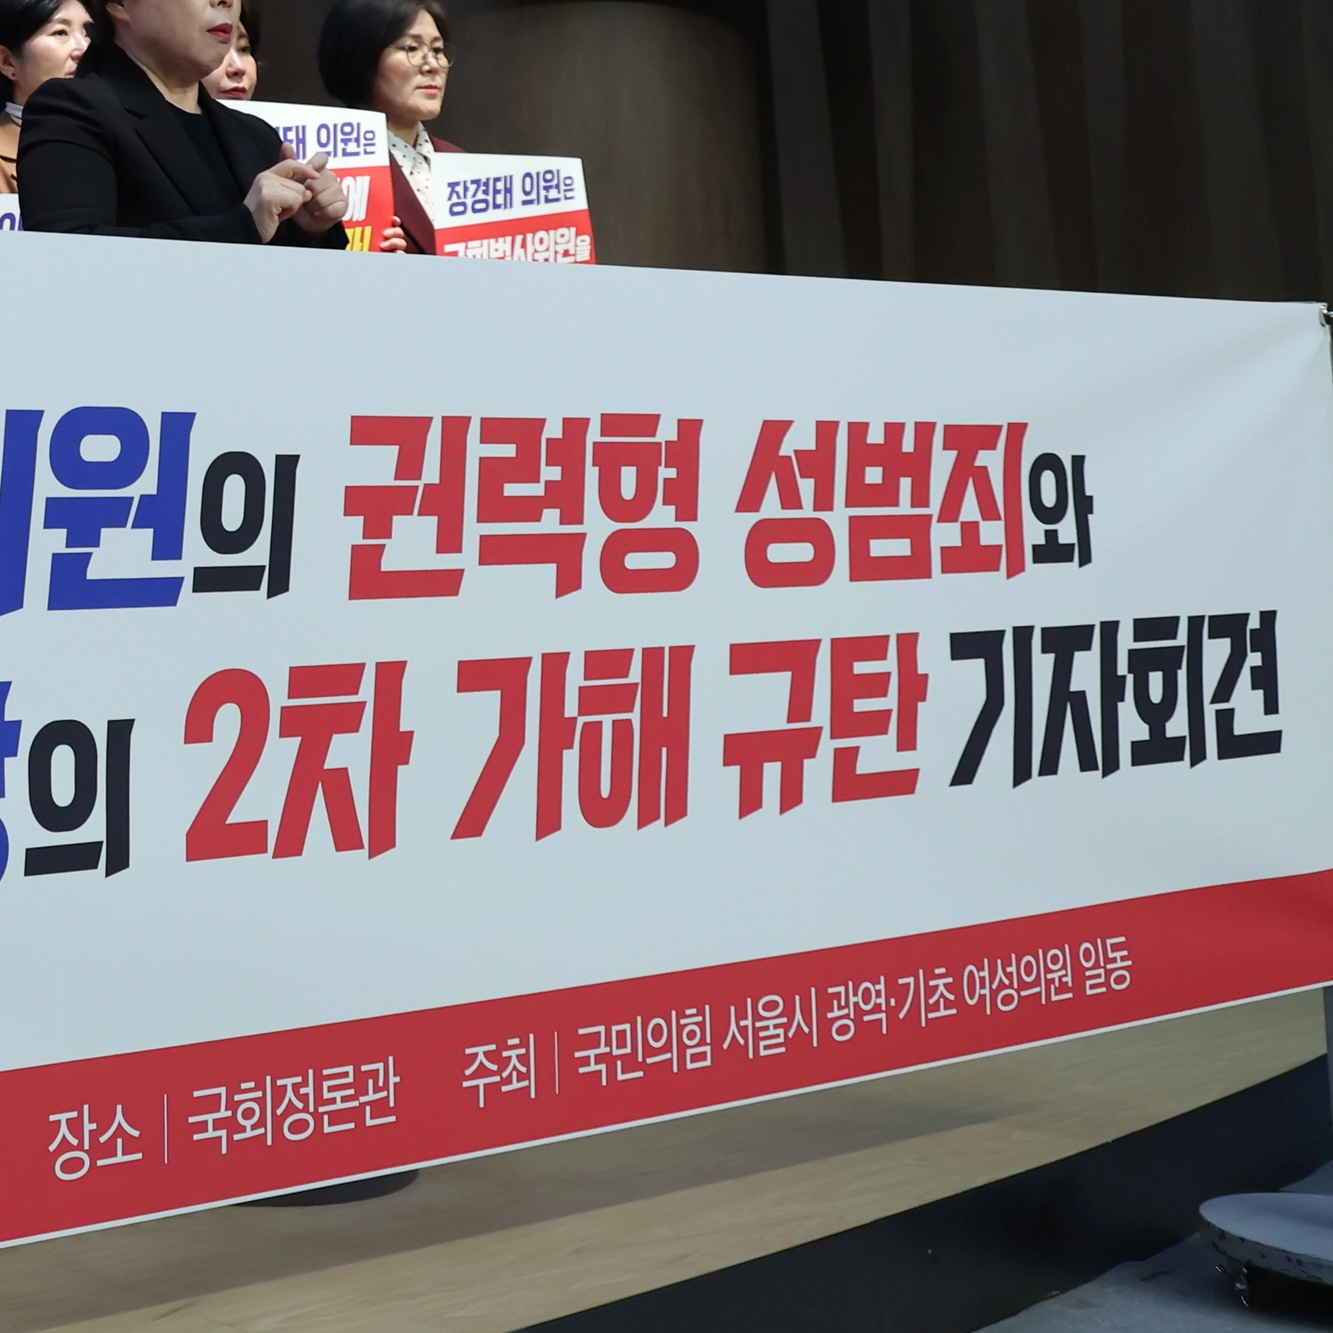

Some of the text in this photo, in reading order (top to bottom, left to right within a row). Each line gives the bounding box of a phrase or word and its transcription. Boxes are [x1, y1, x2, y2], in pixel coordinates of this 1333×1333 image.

[315, 121, 377, 160] 의원은
[446, 168, 576, 217] 장경태 의원은
[344, 413, 704, 600] 권력형
[736, 419, 1094, 588] 성범죄와
[184, 660, 414, 861] 2차
[451, 644, 695, 841] 가해
[723, 632, 929, 819] 규탄
[948, 610, 1283, 789] 기자회견
[48, 1104, 143, 1181] 장소
[188, 1056, 401, 1154] 국회정론관
[462, 1033, 536, 1108] 주최
[574, 1004, 712, 1086] 국민의힘
[722, 987, 818, 1059] 서울시
[826, 967, 957, 1042] 광역·기초
[963, 944, 1073, 1015] 여성의원
[1079, 936, 1133, 996] 일동
